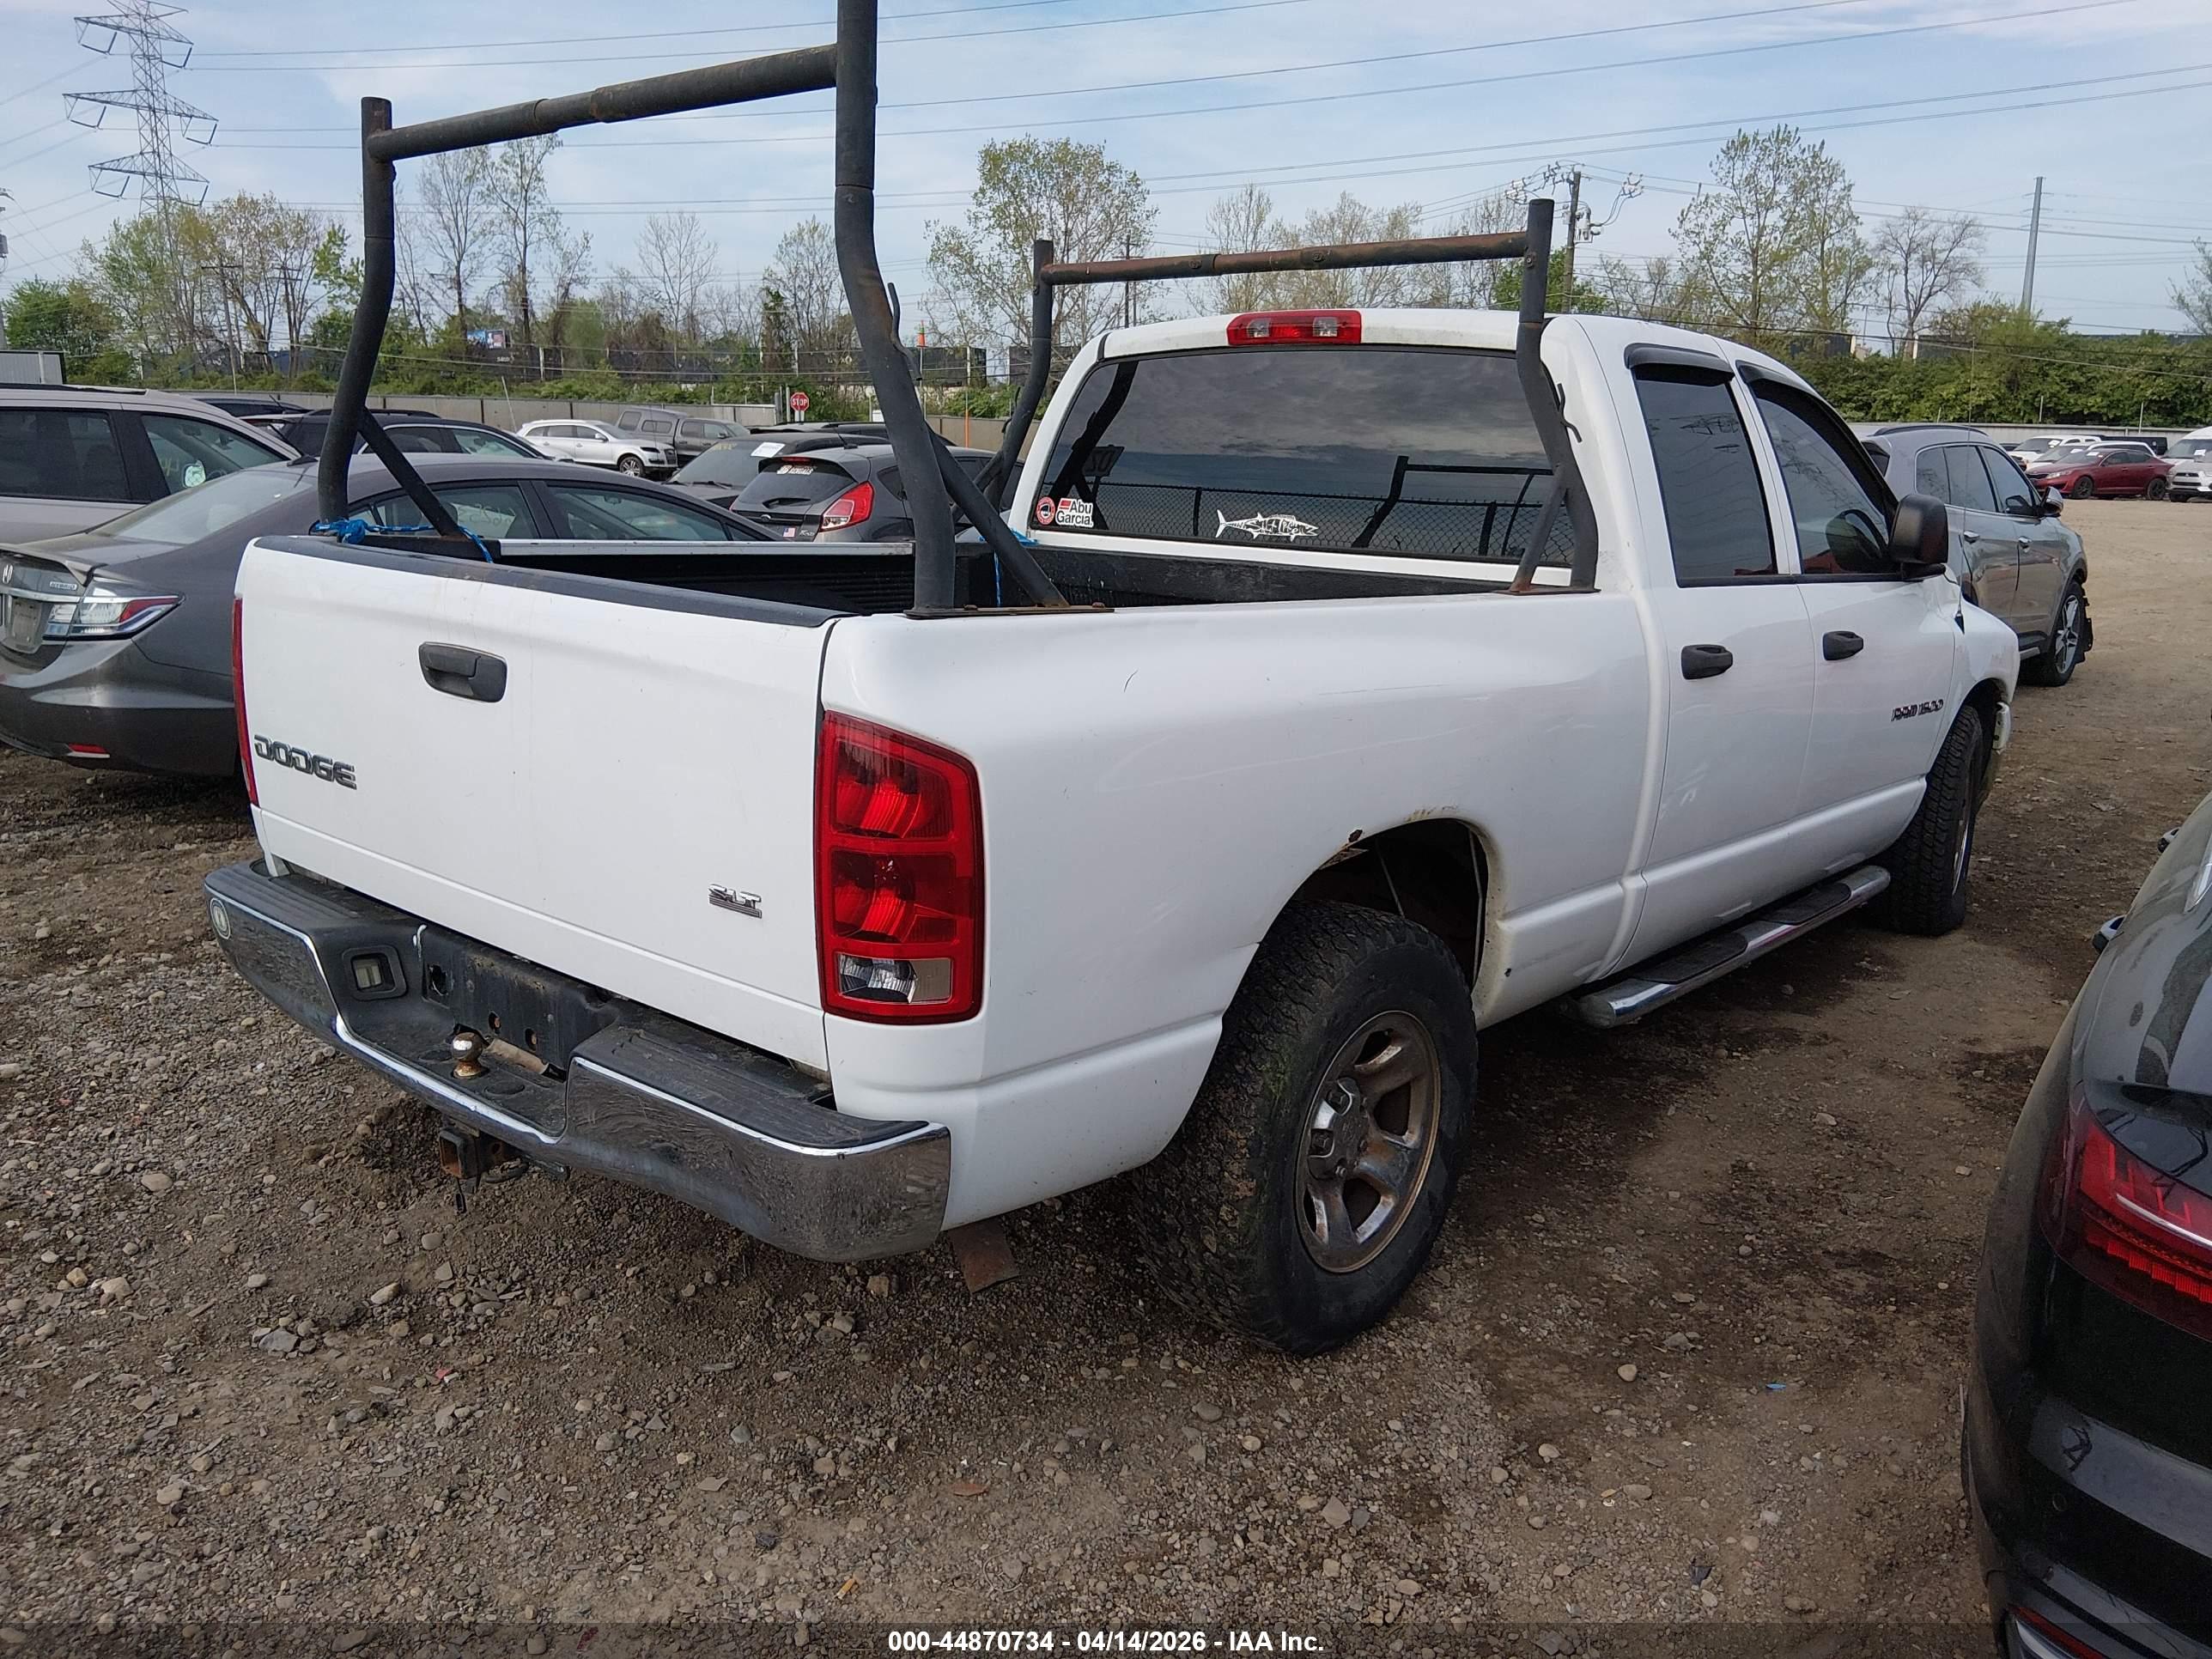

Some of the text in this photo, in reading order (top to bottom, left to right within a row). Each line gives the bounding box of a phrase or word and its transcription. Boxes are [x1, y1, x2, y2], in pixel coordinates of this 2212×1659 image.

[792, 398, 808, 406] STOP
[1070, 499, 1091, 514] Abu
[1891, 699, 1944, 721] RAM 1500
[253, 733, 357, 790] DODGE
[708, 883, 762, 910] SLT
